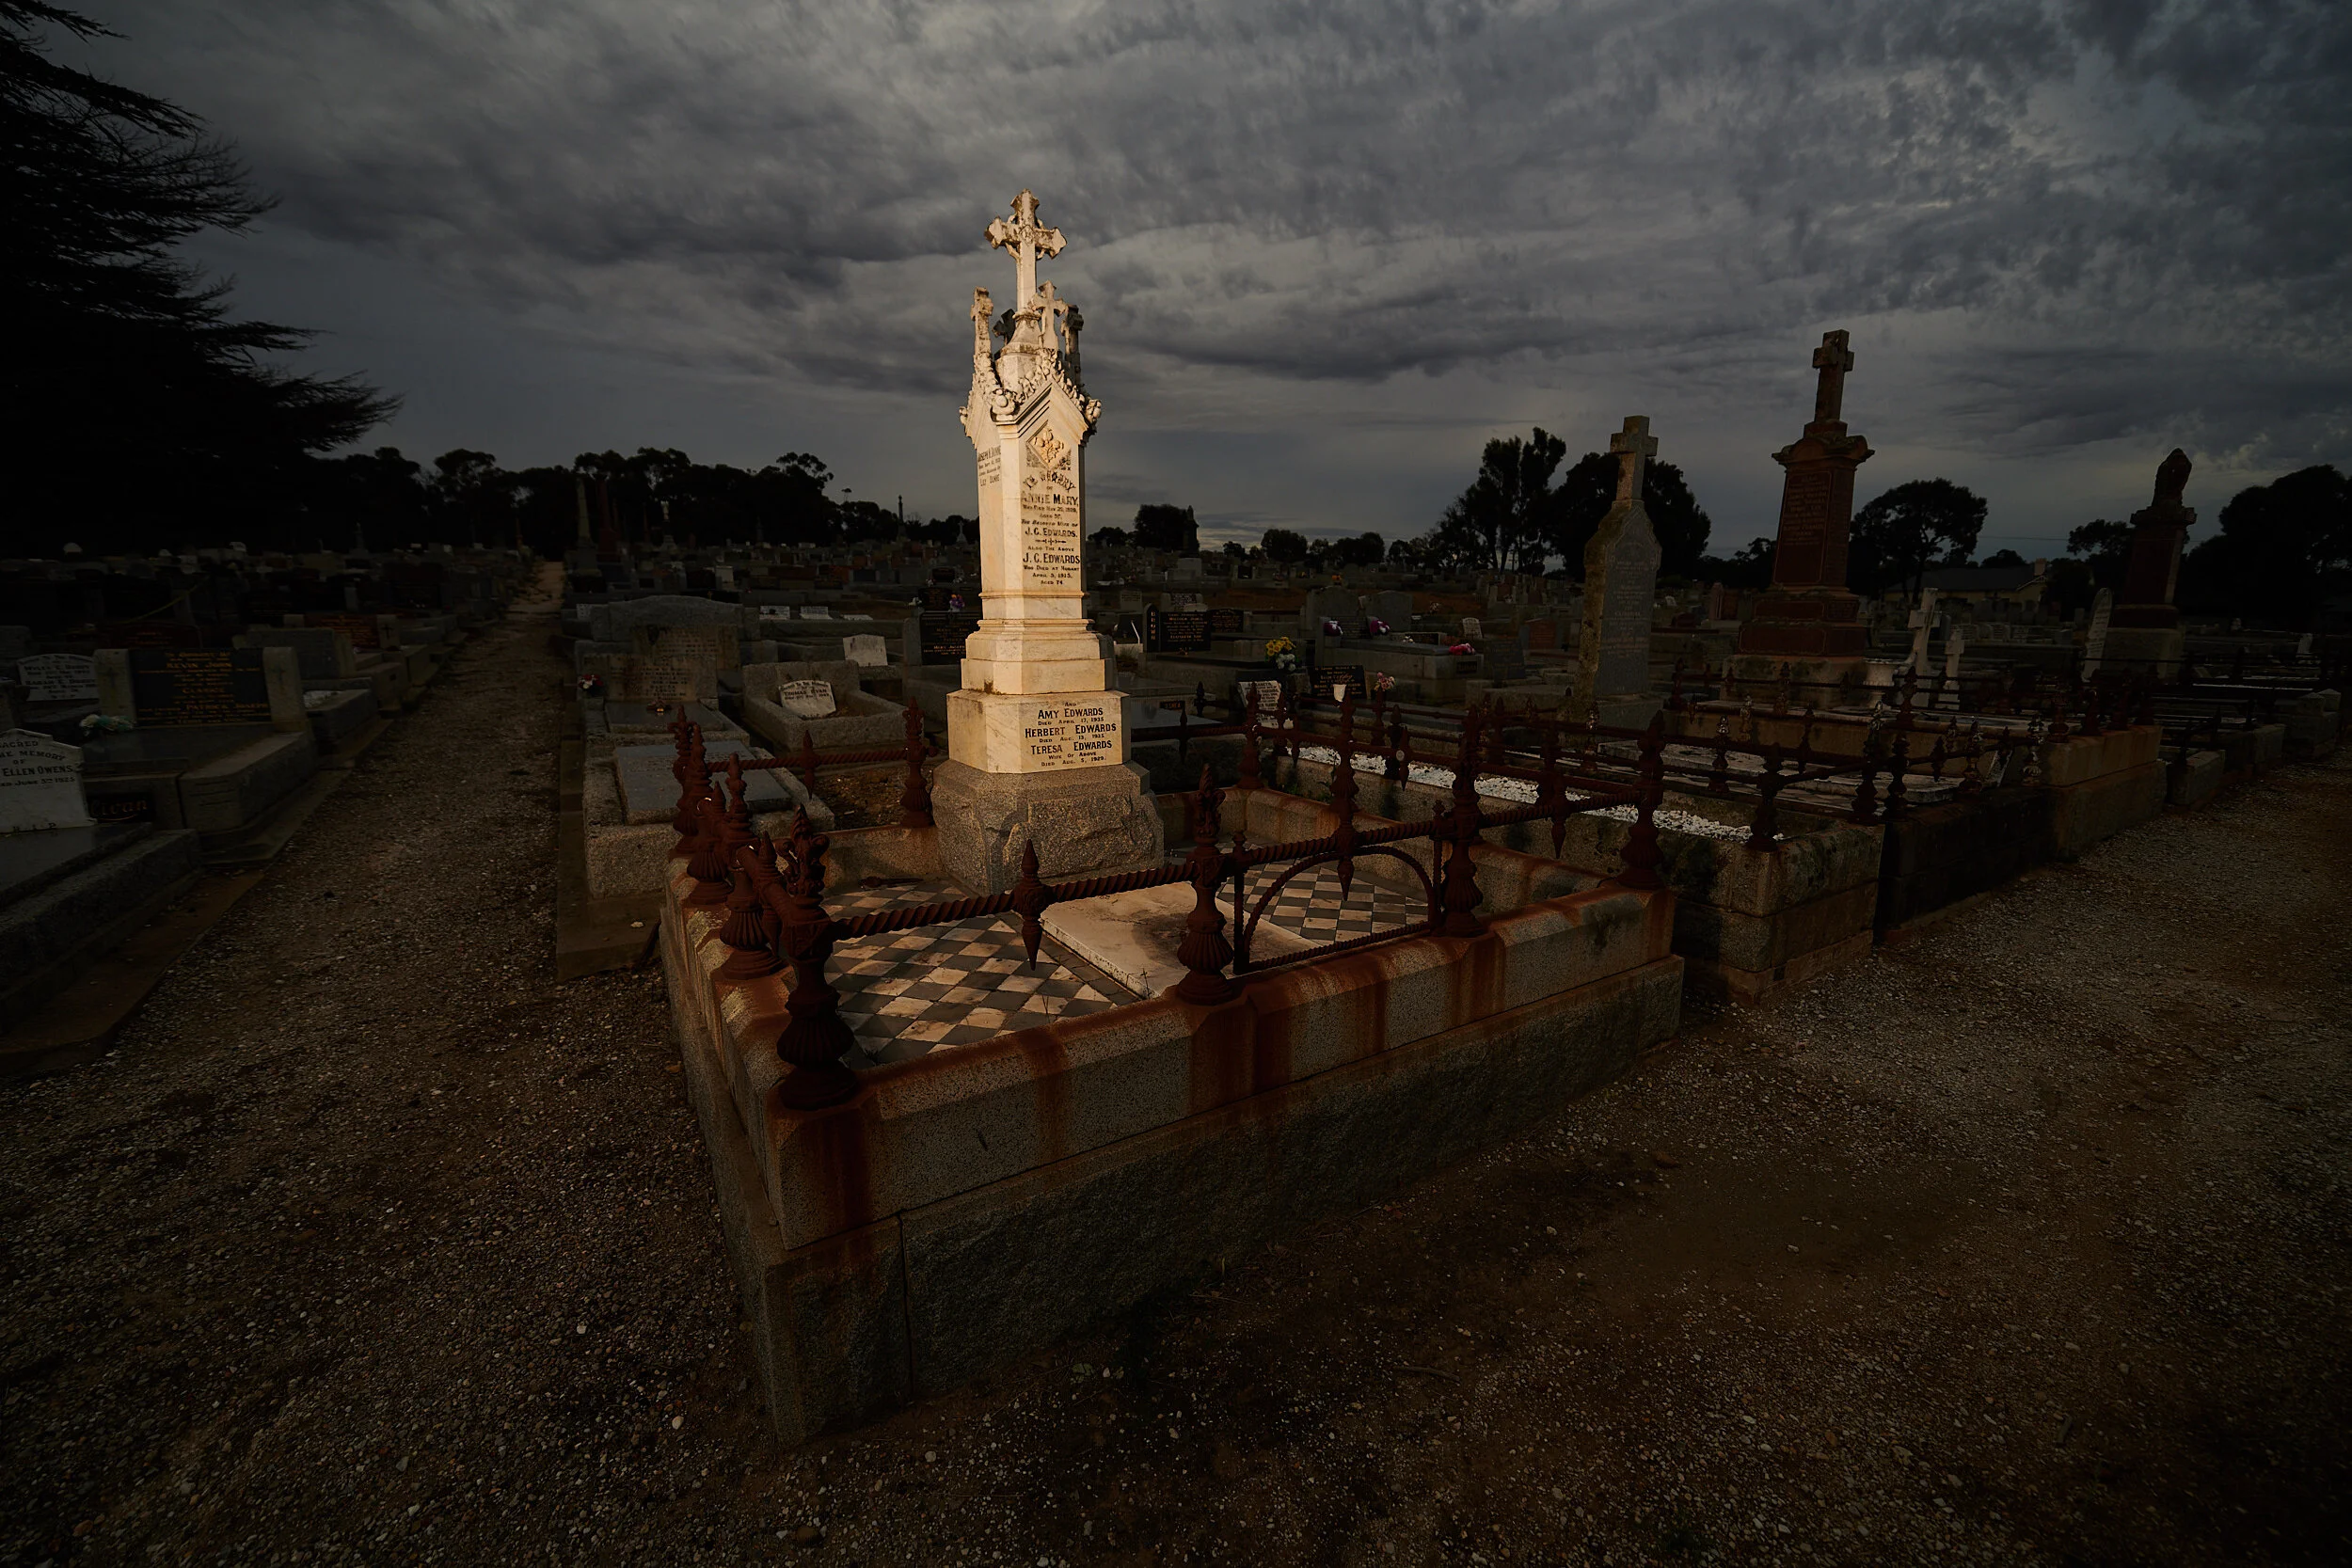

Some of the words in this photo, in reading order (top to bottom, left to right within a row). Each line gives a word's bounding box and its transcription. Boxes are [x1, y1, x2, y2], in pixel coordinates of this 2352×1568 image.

[1042, 553, 1080, 564] EDWARDS
[1038, 709, 1059, 720] AMY
[1064, 707, 1104, 718] EDWARDS
[1025, 726, 1066, 738] HERBERT
[1074, 723, 1117, 735] EDWARDS
[1031, 744, 1063, 755] TERESA
[1073, 740, 1112, 752] EDWARDS
[20, 751, 66, 761] MEMORY
[3, 768, 35, 777] ELLEN
[37, 765, 73, 775] OWENS
